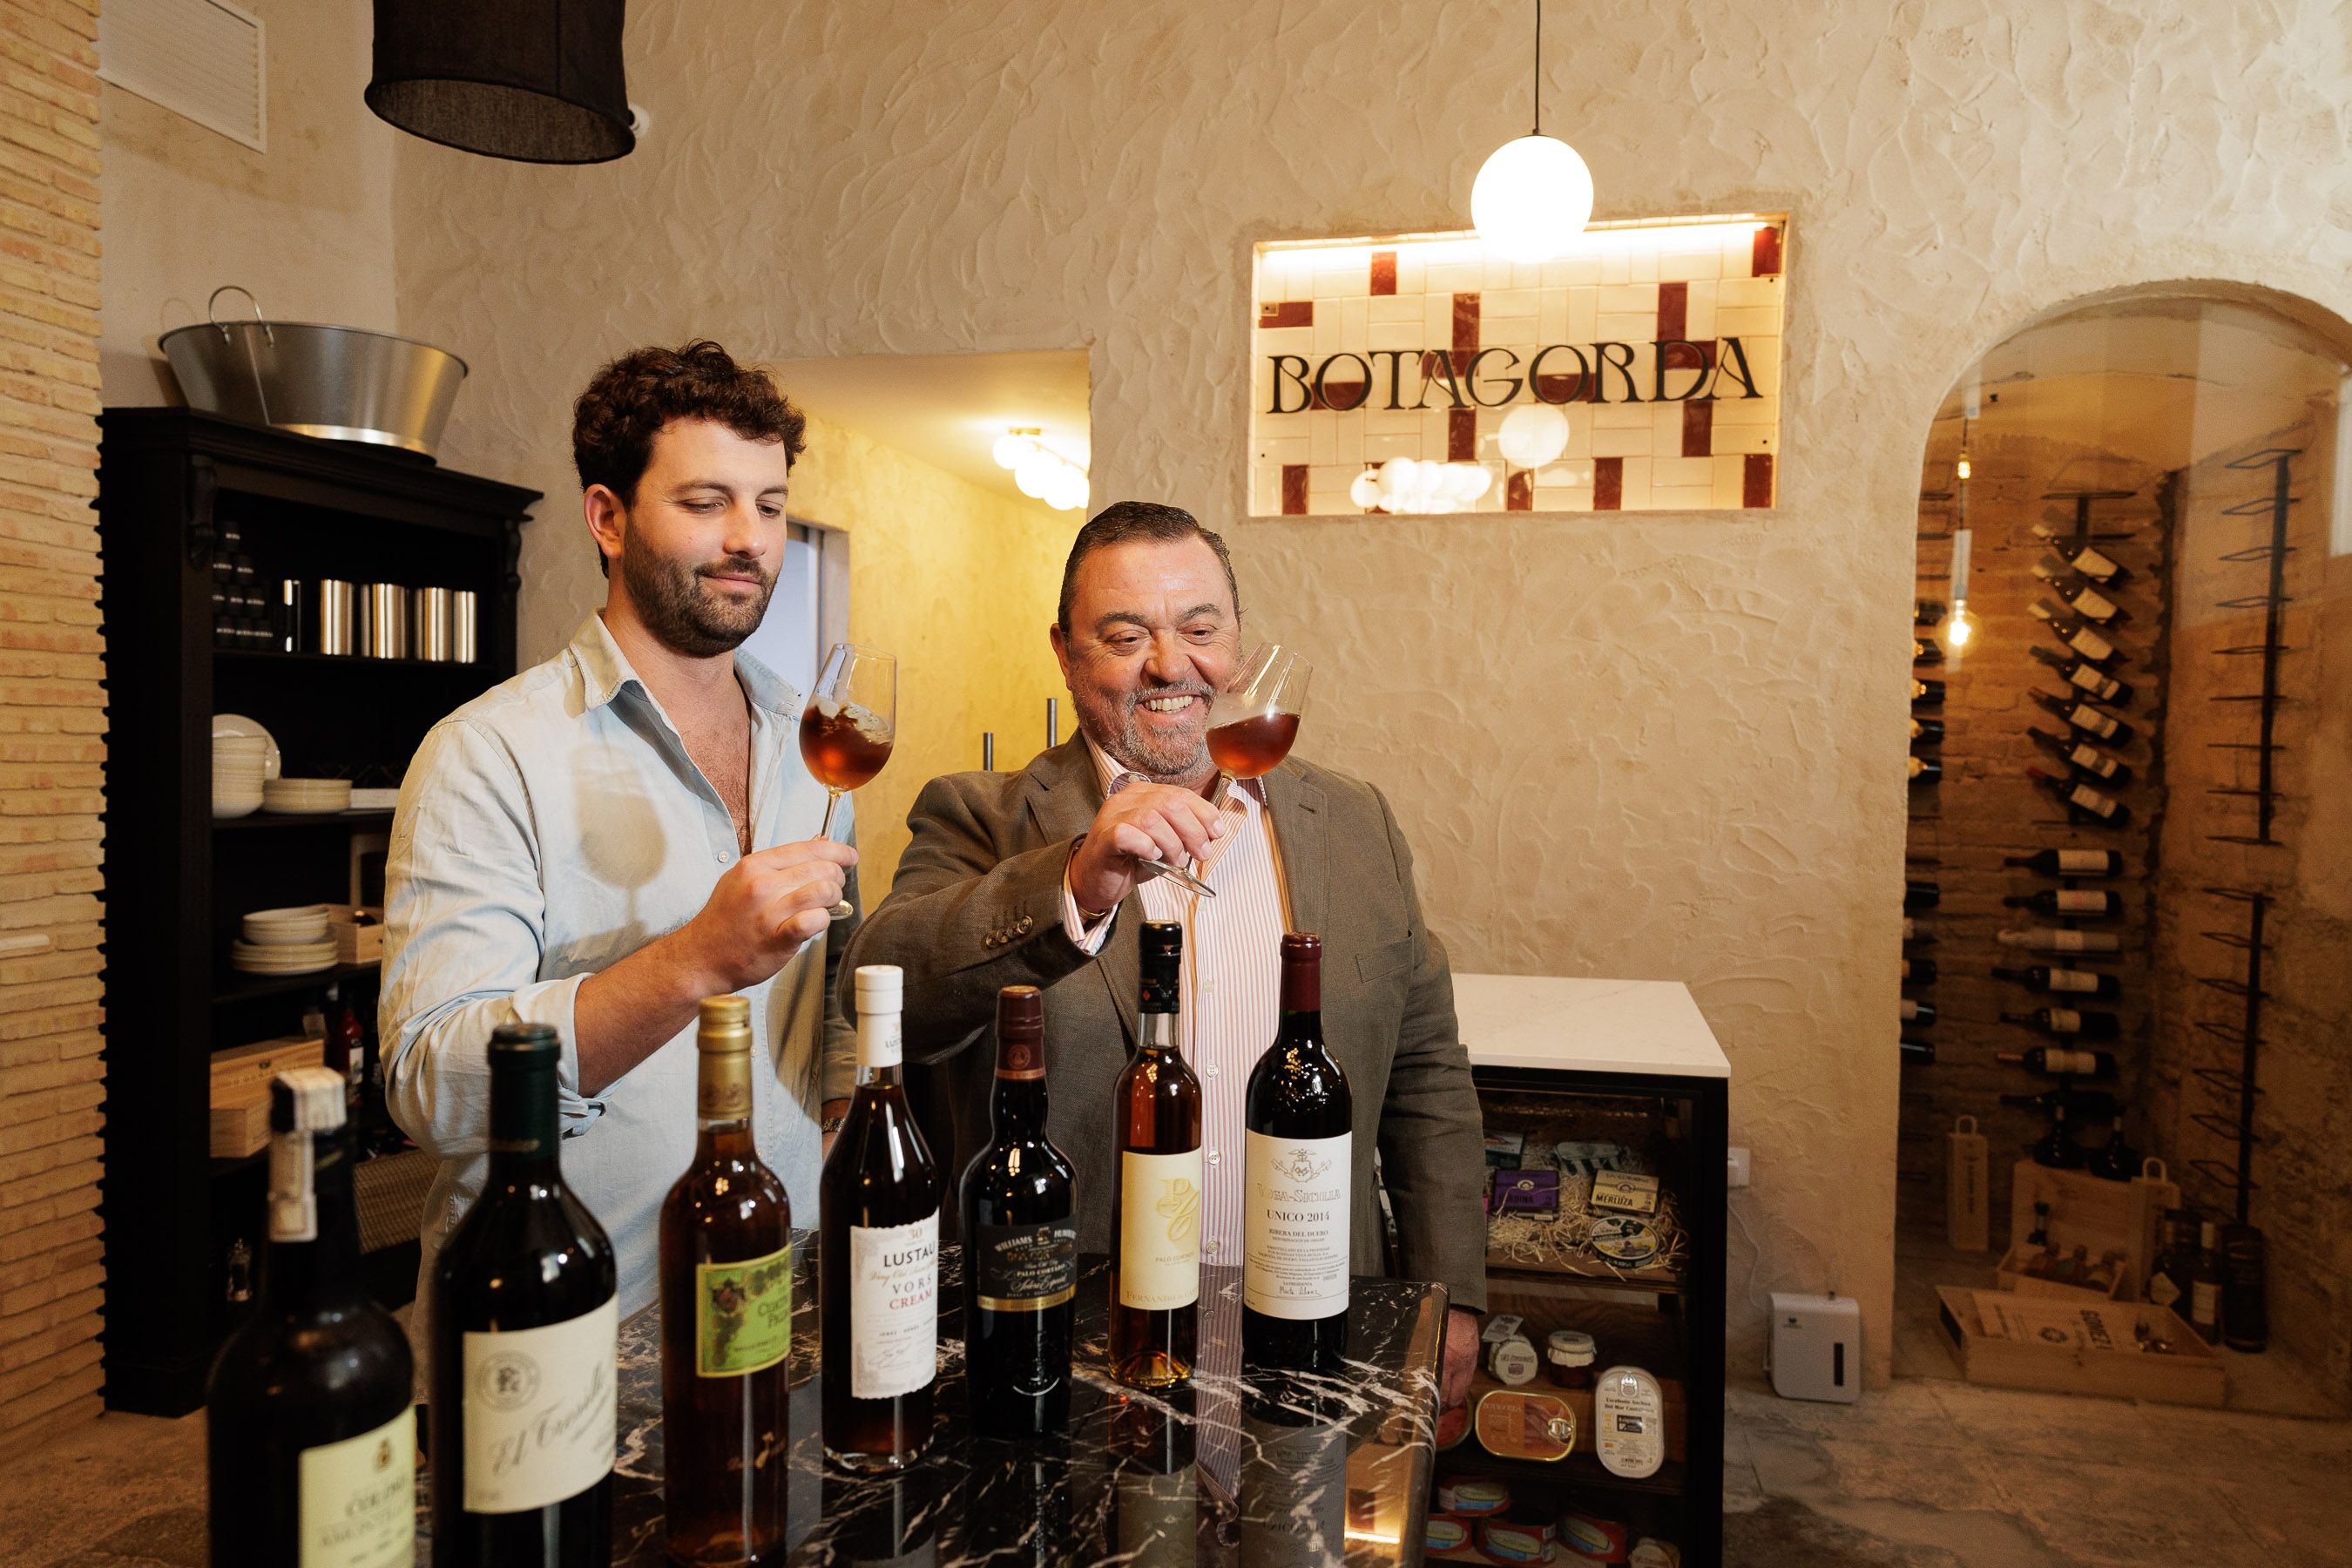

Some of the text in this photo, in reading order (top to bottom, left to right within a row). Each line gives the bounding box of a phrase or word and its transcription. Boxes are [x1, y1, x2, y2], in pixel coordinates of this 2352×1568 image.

[1266, 336, 1764, 415] BOTAGORDA
[1595, 1193, 1634, 1206] MERLUZA
[1267, 1209, 1330, 1223] UNICO 2014
[883, 1240, 936, 1268] LUSTAU
[889, 1287, 933, 1310] CREAM
